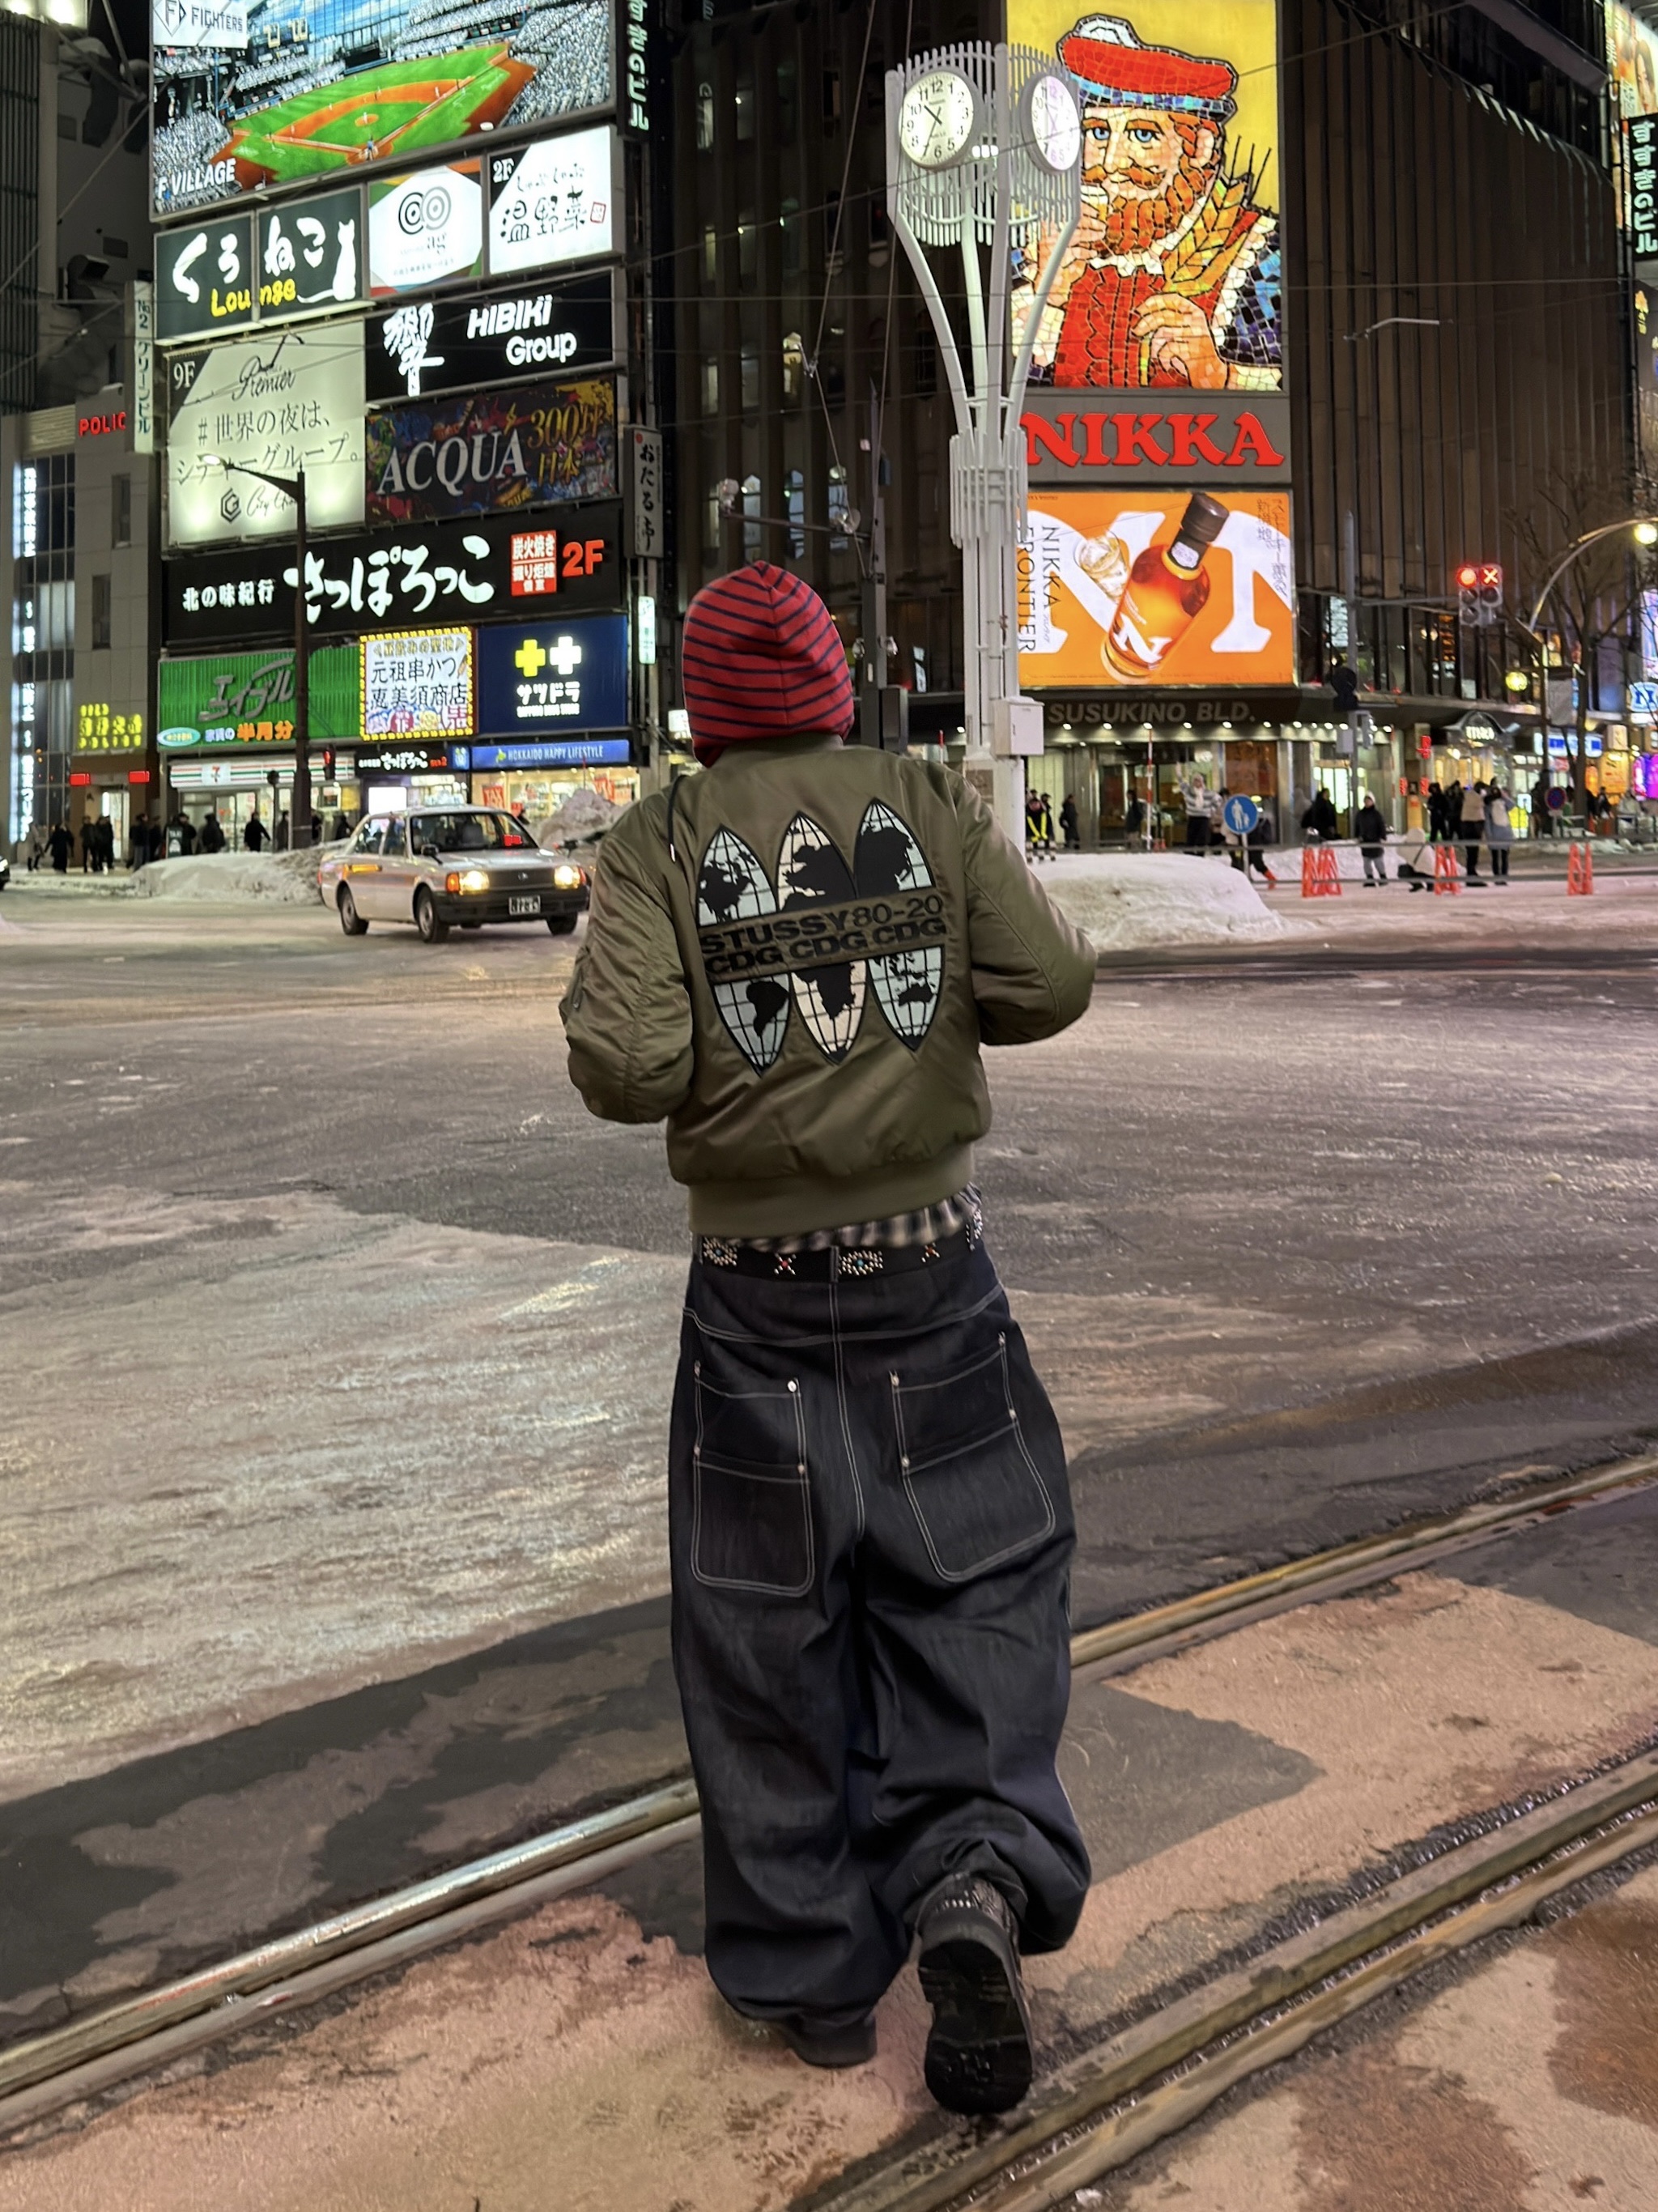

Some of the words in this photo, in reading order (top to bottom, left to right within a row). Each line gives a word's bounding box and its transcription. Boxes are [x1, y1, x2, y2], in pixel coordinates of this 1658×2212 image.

[191, 5, 243, 32] FIGHTERS
[158, 177, 168, 199] F
[171, 158, 236, 196] VILLAGE
[493, 160, 515, 183] 2F
[500, 185, 588, 244] 温野菜
[172, 215, 326, 304] くろねこ
[210, 279, 297, 318] Lounge
[382, 303, 445, 397] 響
[506, 332, 577, 366] Group
[173, 361, 196, 390] 9F
[79, 411, 127, 437] POLIC
[1018, 410, 1285, 467] NIKKA
[376, 428, 528, 497] ACQUA
[562, 538, 606, 578] 2F
[1041, 525, 1061, 610] NIKKA
[182, 577, 274, 612] 北の味紀行
[283, 534, 495, 624] さっぽろっこ
[1016, 526, 1036, 653] FRONTIER
[198, 657, 295, 722] エイブル
[371, 657, 457, 684] 元祖串かつ
[516, 681, 580, 705] サツドラ
[1048, 701, 1186, 723] SUSUKINO
[1196, 700, 1255, 722] BLD.
[236, 720, 294, 742] 半月分
[508, 747, 544, 761] HOKKAIDO
[544, 746, 567, 759] HAPPY
[568, 744, 604, 759] LIFESTYLE
[705, 945, 783, 972] CDG
[789, 932, 869, 959] CDG
[873, 917, 948, 946] CDG
